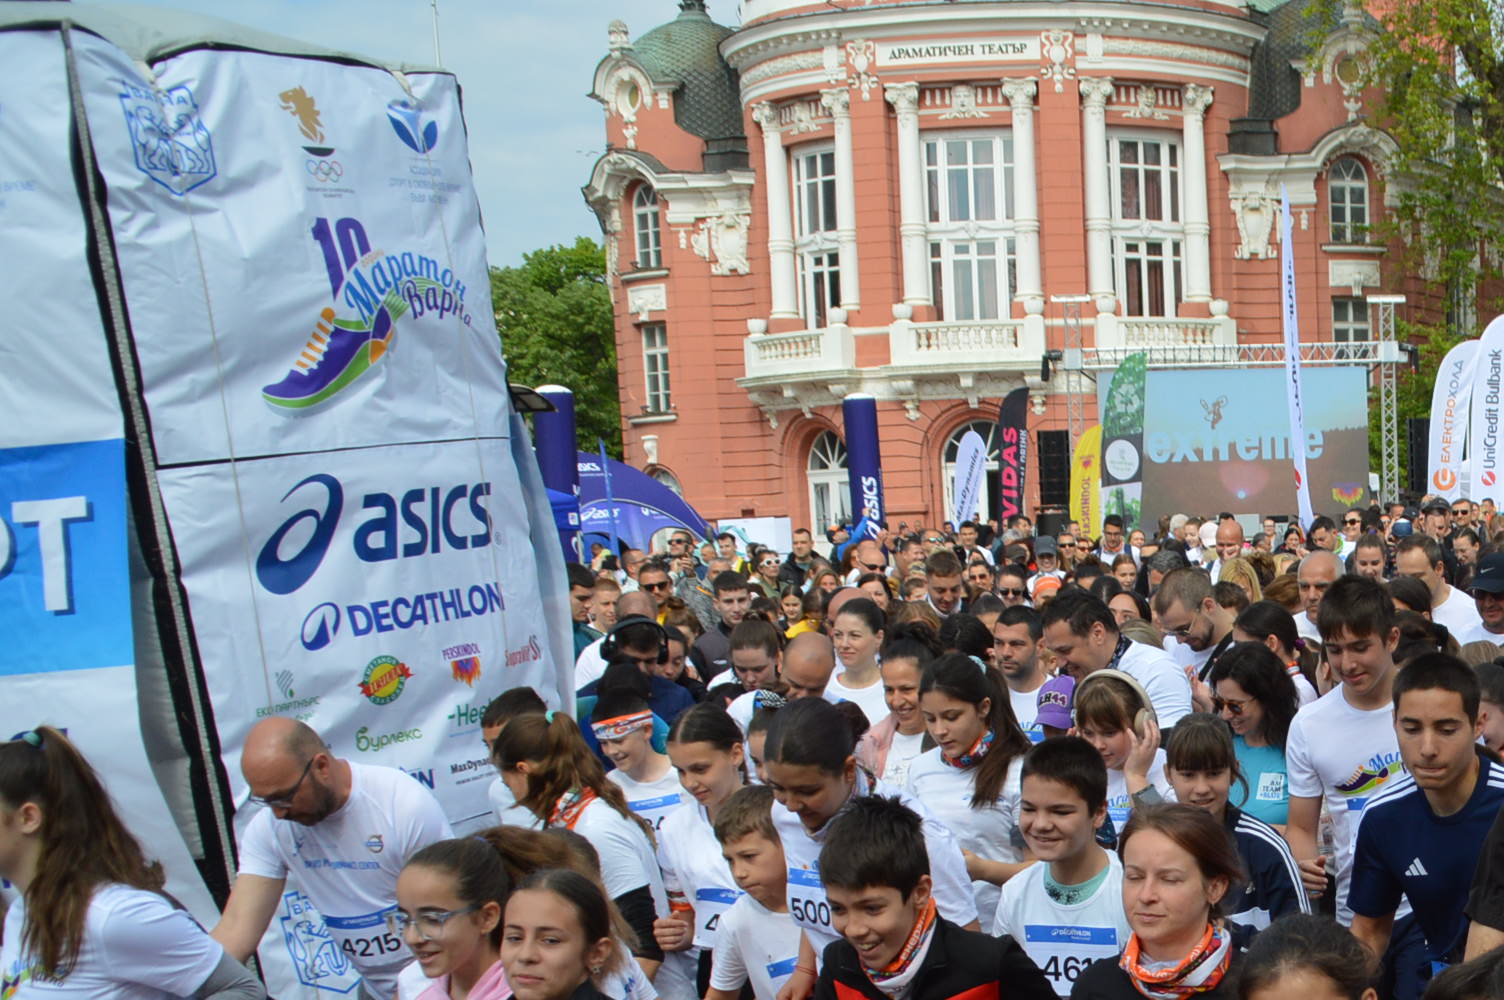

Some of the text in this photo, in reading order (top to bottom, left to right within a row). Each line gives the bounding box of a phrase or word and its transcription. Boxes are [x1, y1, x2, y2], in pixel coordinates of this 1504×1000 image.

[889, 43, 1027, 60] ДРАМАТИЧЕН ТЕАТЪР
[344, 251, 466, 328] Маратон
[401, 280, 472, 328] Варна
[1483, 348, 1502, 469] UniCredit Bulbank
[347, 582, 505, 638] DECATHLON
[342, 932, 401, 957] 4215
